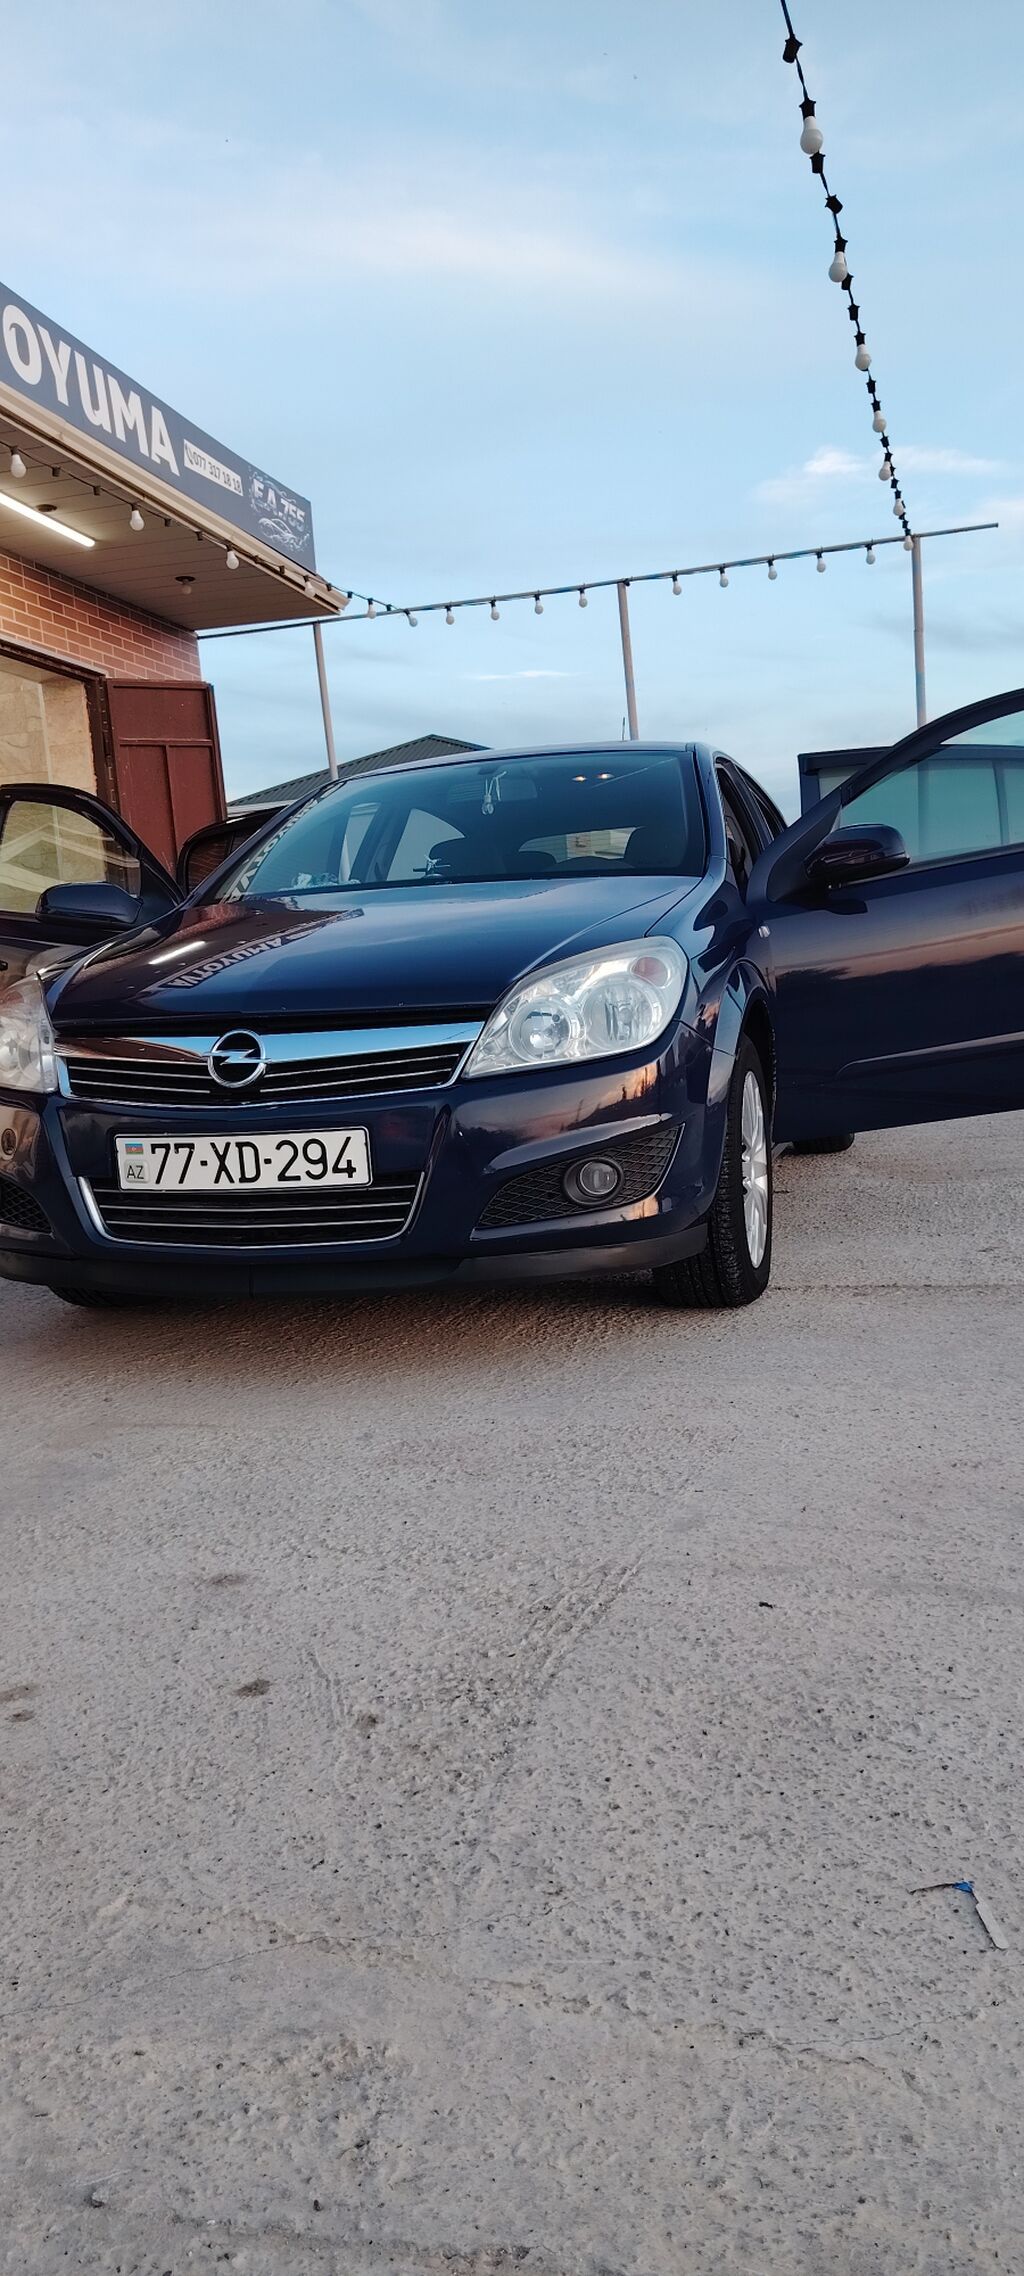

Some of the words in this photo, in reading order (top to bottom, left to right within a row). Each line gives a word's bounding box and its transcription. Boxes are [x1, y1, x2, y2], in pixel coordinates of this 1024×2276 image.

[2, 304, 180, 477] OYUMA
[193, 451, 206, 470] 077
[126, 1165, 144, 1179] AZ
[150, 1136, 357, 1184] 77-XD-294
